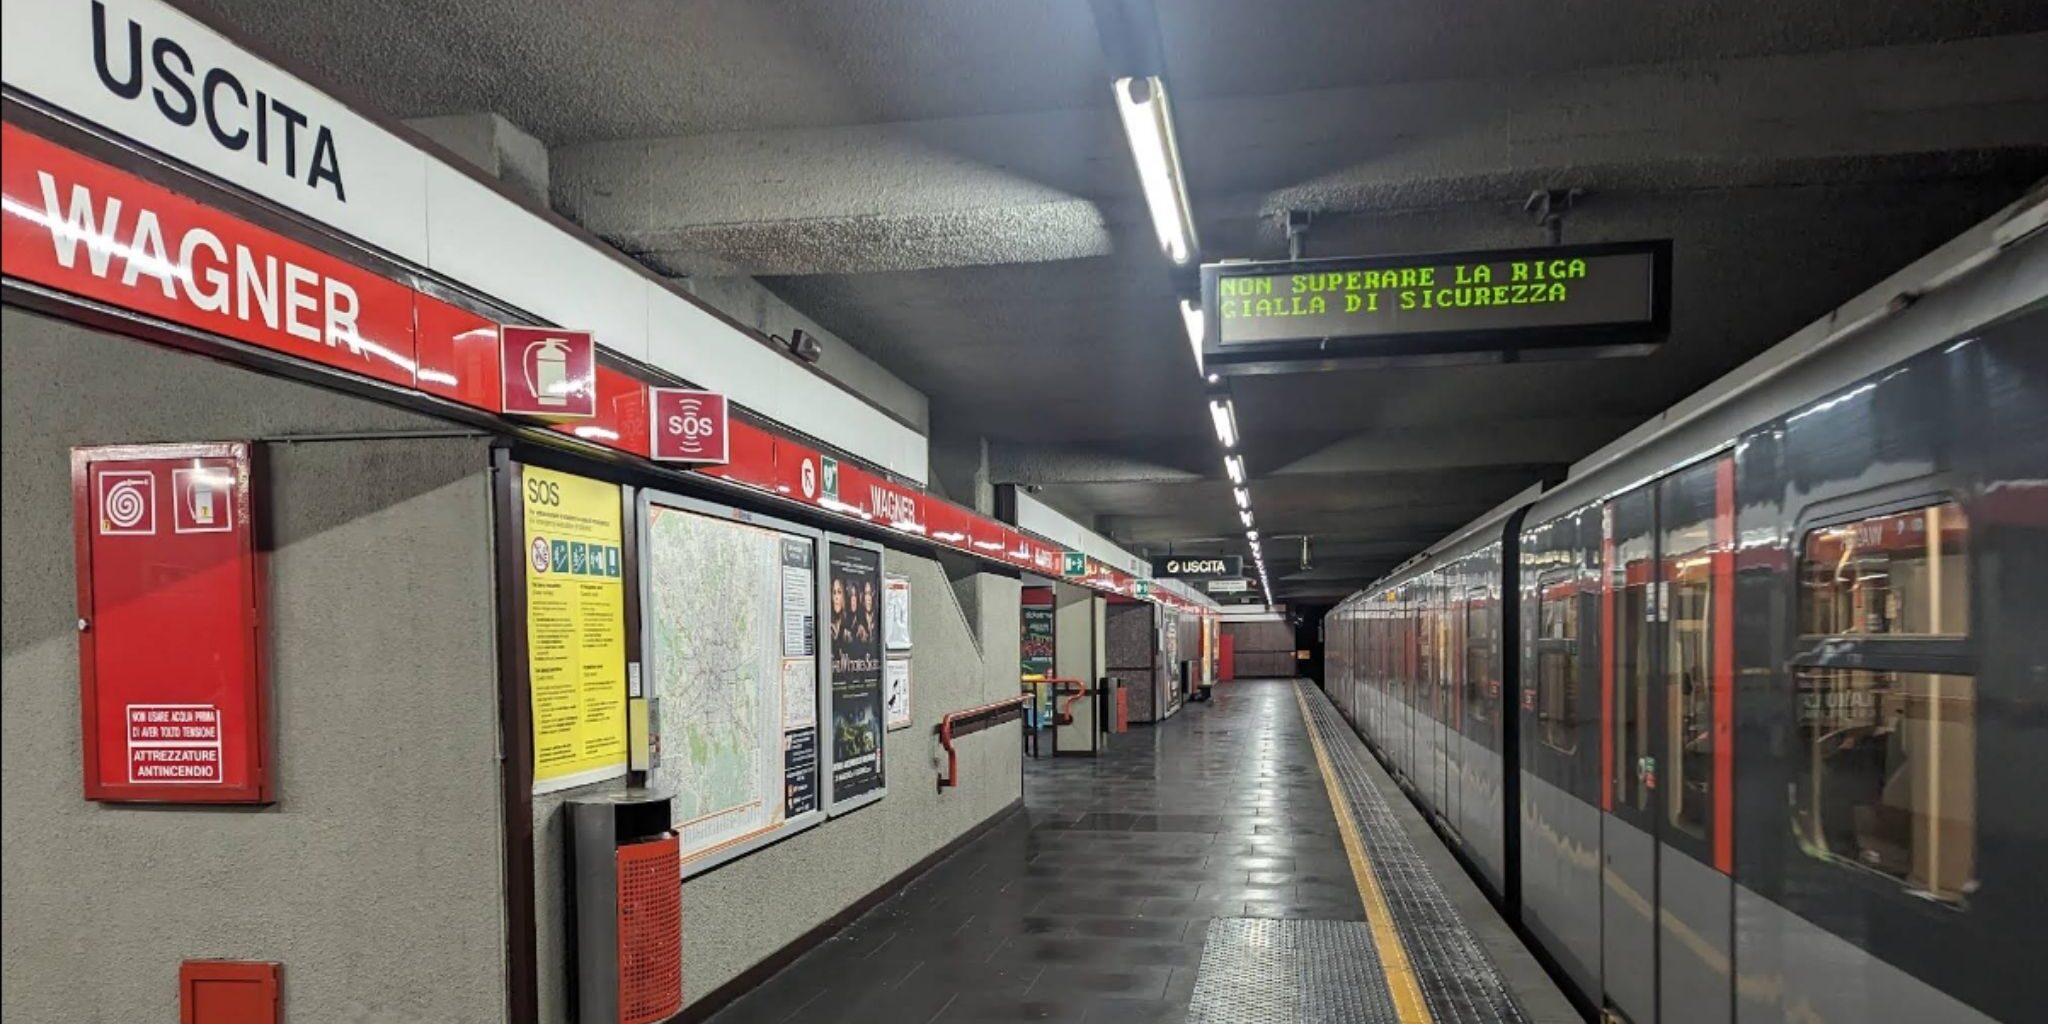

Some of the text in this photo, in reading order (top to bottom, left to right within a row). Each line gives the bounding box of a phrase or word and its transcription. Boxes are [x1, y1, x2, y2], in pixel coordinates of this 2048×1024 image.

[91, 0, 347, 204] USCITA
[37, 170, 364, 355] WAGNER
[1220, 258, 1586, 296] NON SUPERARE LA RIGA
[1220, 283, 1566, 319] GIALLA DI SICUREZZA
[668, 415, 713, 436] SOS
[527, 478, 560, 507] SOS
[870, 484, 915, 524] WAGNER
[1182, 560, 1226, 573] USCITA
[132, 711, 215, 722] NON USARE ACQUA PRIMA
[132, 726, 216, 738] DI AVER TOLTO TENSIONE
[134, 749, 217, 762] ATTREZZATURE
[137, 765, 214, 777] ANTINCENDIO
